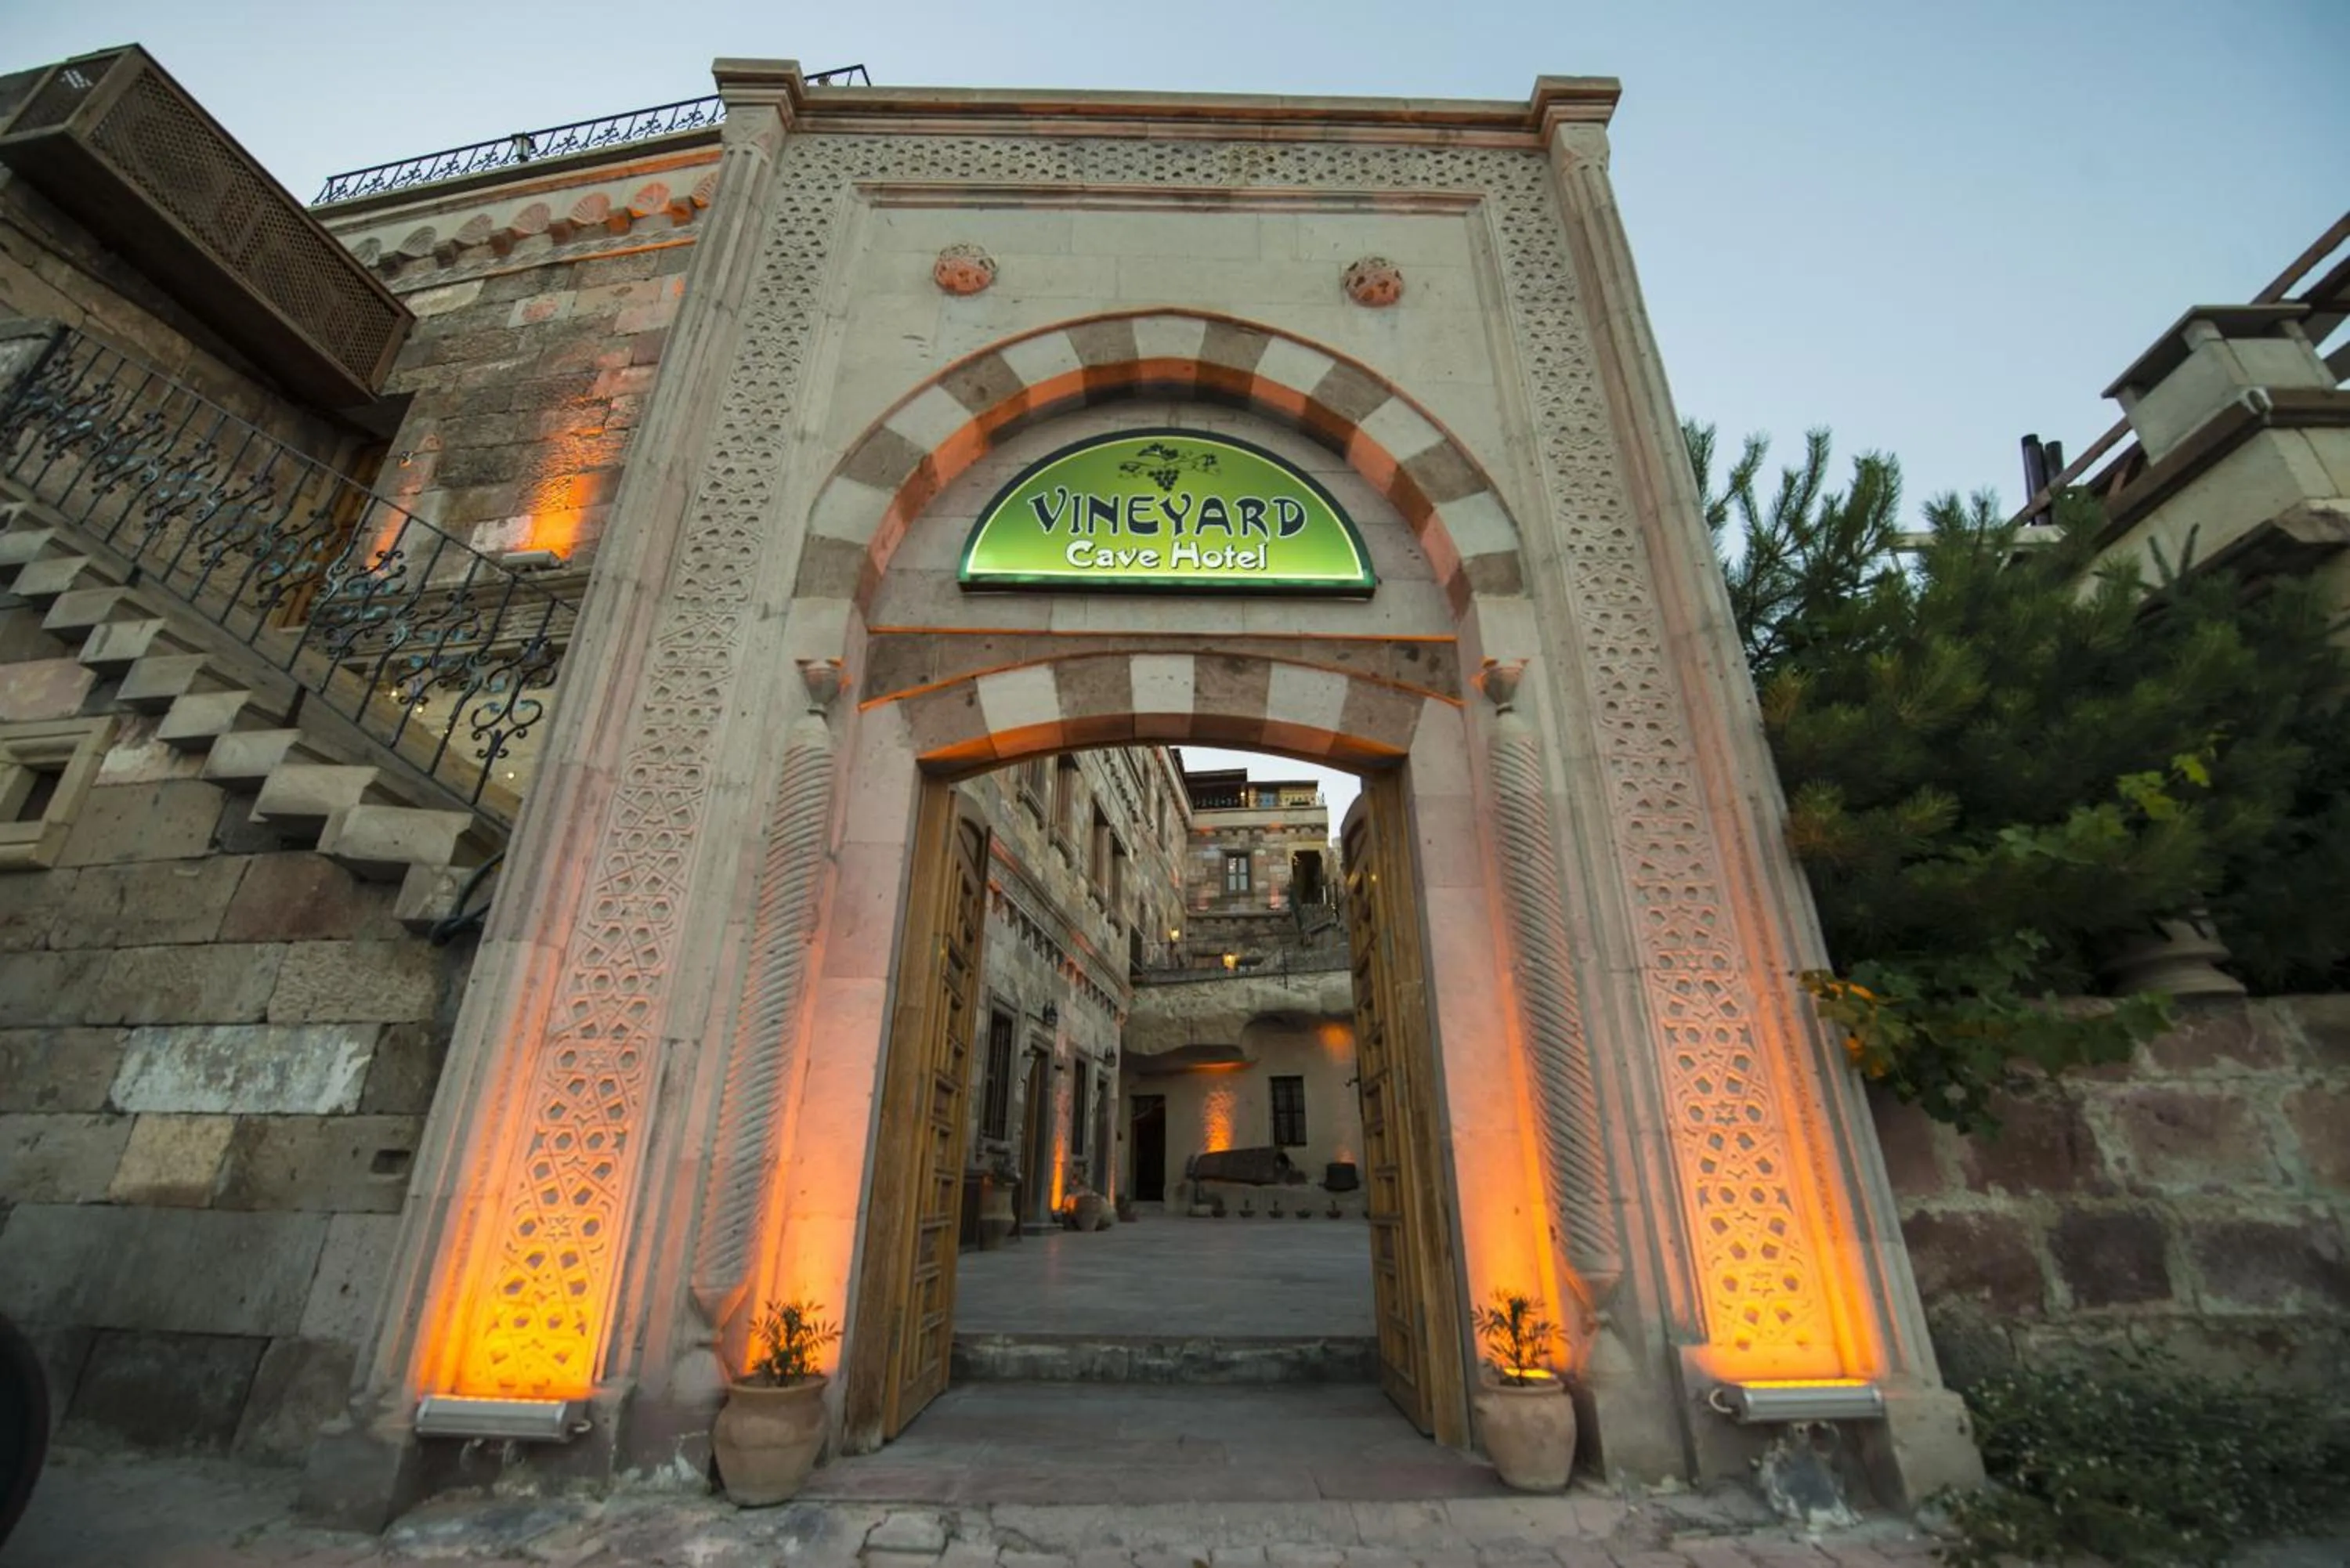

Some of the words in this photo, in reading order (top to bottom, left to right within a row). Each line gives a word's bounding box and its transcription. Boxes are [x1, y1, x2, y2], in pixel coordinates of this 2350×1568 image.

[1029, 486, 1307, 539] VINEYARD
[1066, 540, 1160, 569] Cave
[1170, 541, 1267, 569] Hotel
